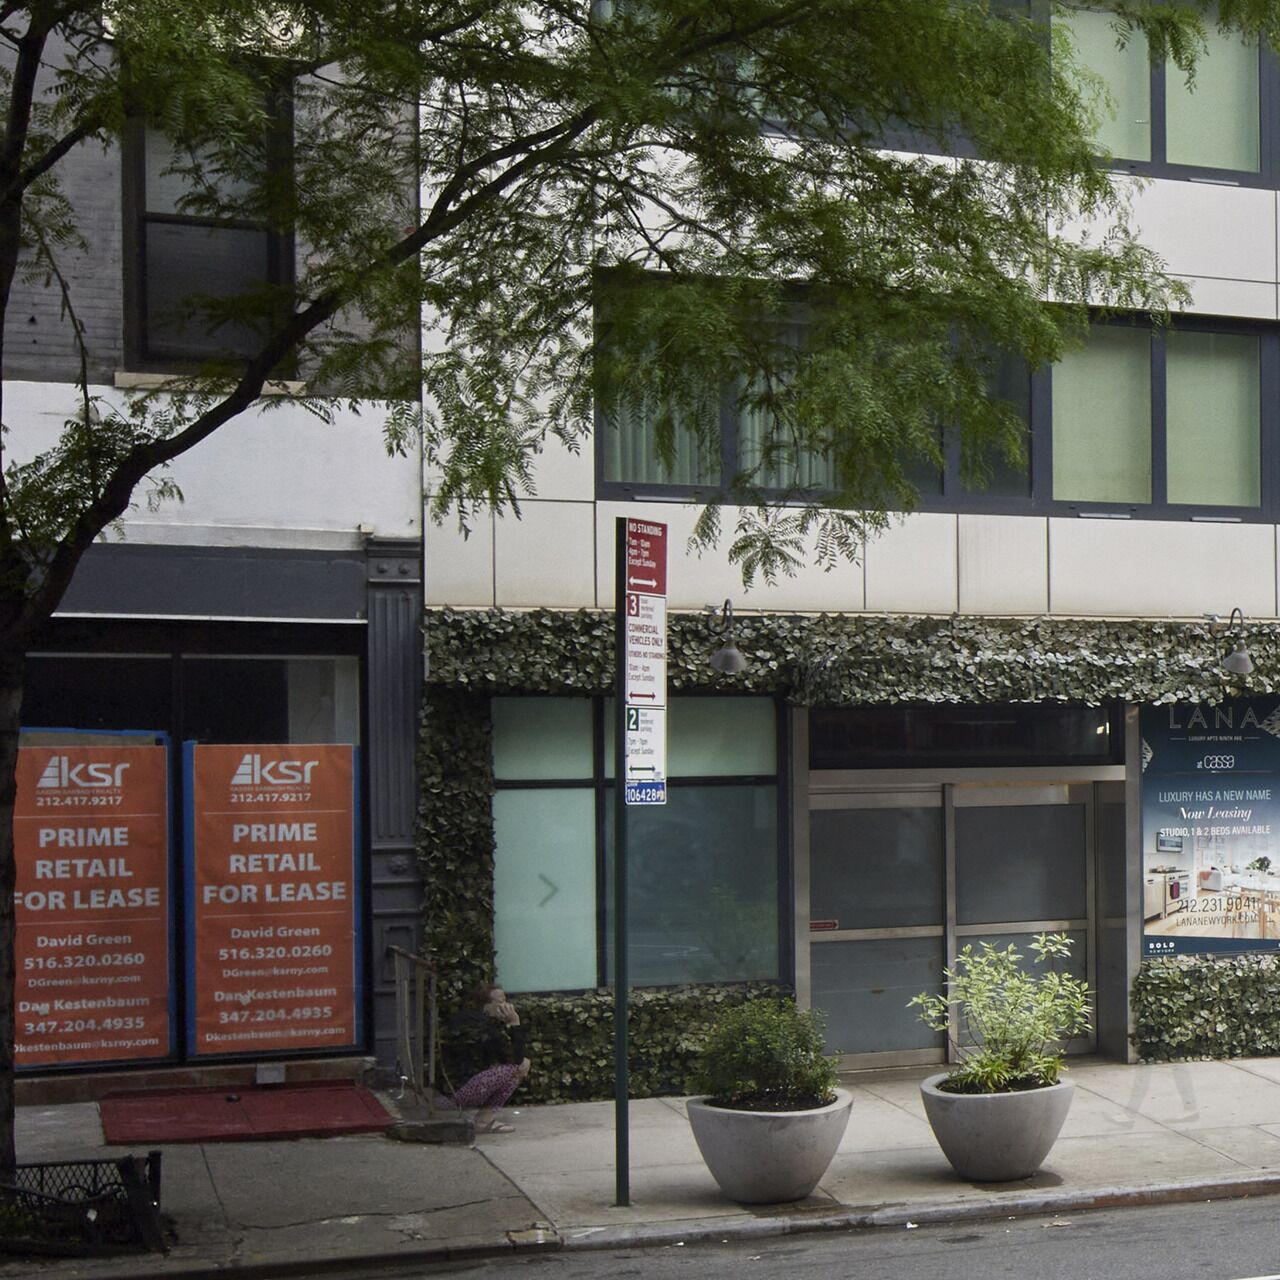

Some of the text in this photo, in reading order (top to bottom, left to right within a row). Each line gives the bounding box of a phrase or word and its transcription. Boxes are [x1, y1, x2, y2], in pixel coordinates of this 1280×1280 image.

[628, 522, 663, 537] NO STANDING
[630, 595, 637, 615] 3
[628, 622, 659, 635] COMMERCIAL
[628, 635, 663, 647] VEHICLES ONLY
[629, 709, 637, 730] 2
[1169, 704, 1260, 729] LANA
[1204, 755, 1235, 769] cassa
[36, 796, 123, 806] 212.417.9217
[230, 792, 312, 803] 212.417.9217
[627, 788, 656, 802] 106428
[1158, 789, 1272, 803] LUXURY HAS A NEW NAME
[1179, 806, 1252, 822] Now Leasing
[39, 827, 129, 848] PRIME
[232, 823, 318, 843] PRIME
[1160, 827, 1190, 838] STUDIO,
[1196, 827, 1203, 836] &
[1204, 827, 1210, 836] 2
[1210, 826, 1231, 836] BEDS
[1232, 825, 1271, 835] AVAILABLE
[35, 858, 133, 880] RETAIL
[229, 852, 321, 873] RETAIL
[14, 888, 160, 911] FOR LEASE
[203, 882, 346, 905] FOR LEASE
[1176, 897, 1257, 913] 212.231.9041
[36, 933, 132, 948] David Green
[230, 926, 320, 939] David Green
[219, 945, 332, 961] 516.320.0260
[1149, 941, 1175, 949] BOLD
[24, 953, 145, 970] 516.320.0260
[214, 986, 337, 1002] Dan Kestenbaum
[19, 996, 150, 1013] Dan Kestenbaum
[219, 1006, 333, 1024] 347.204.4935
[25, 1017, 146, 1035] 347.204.4935
